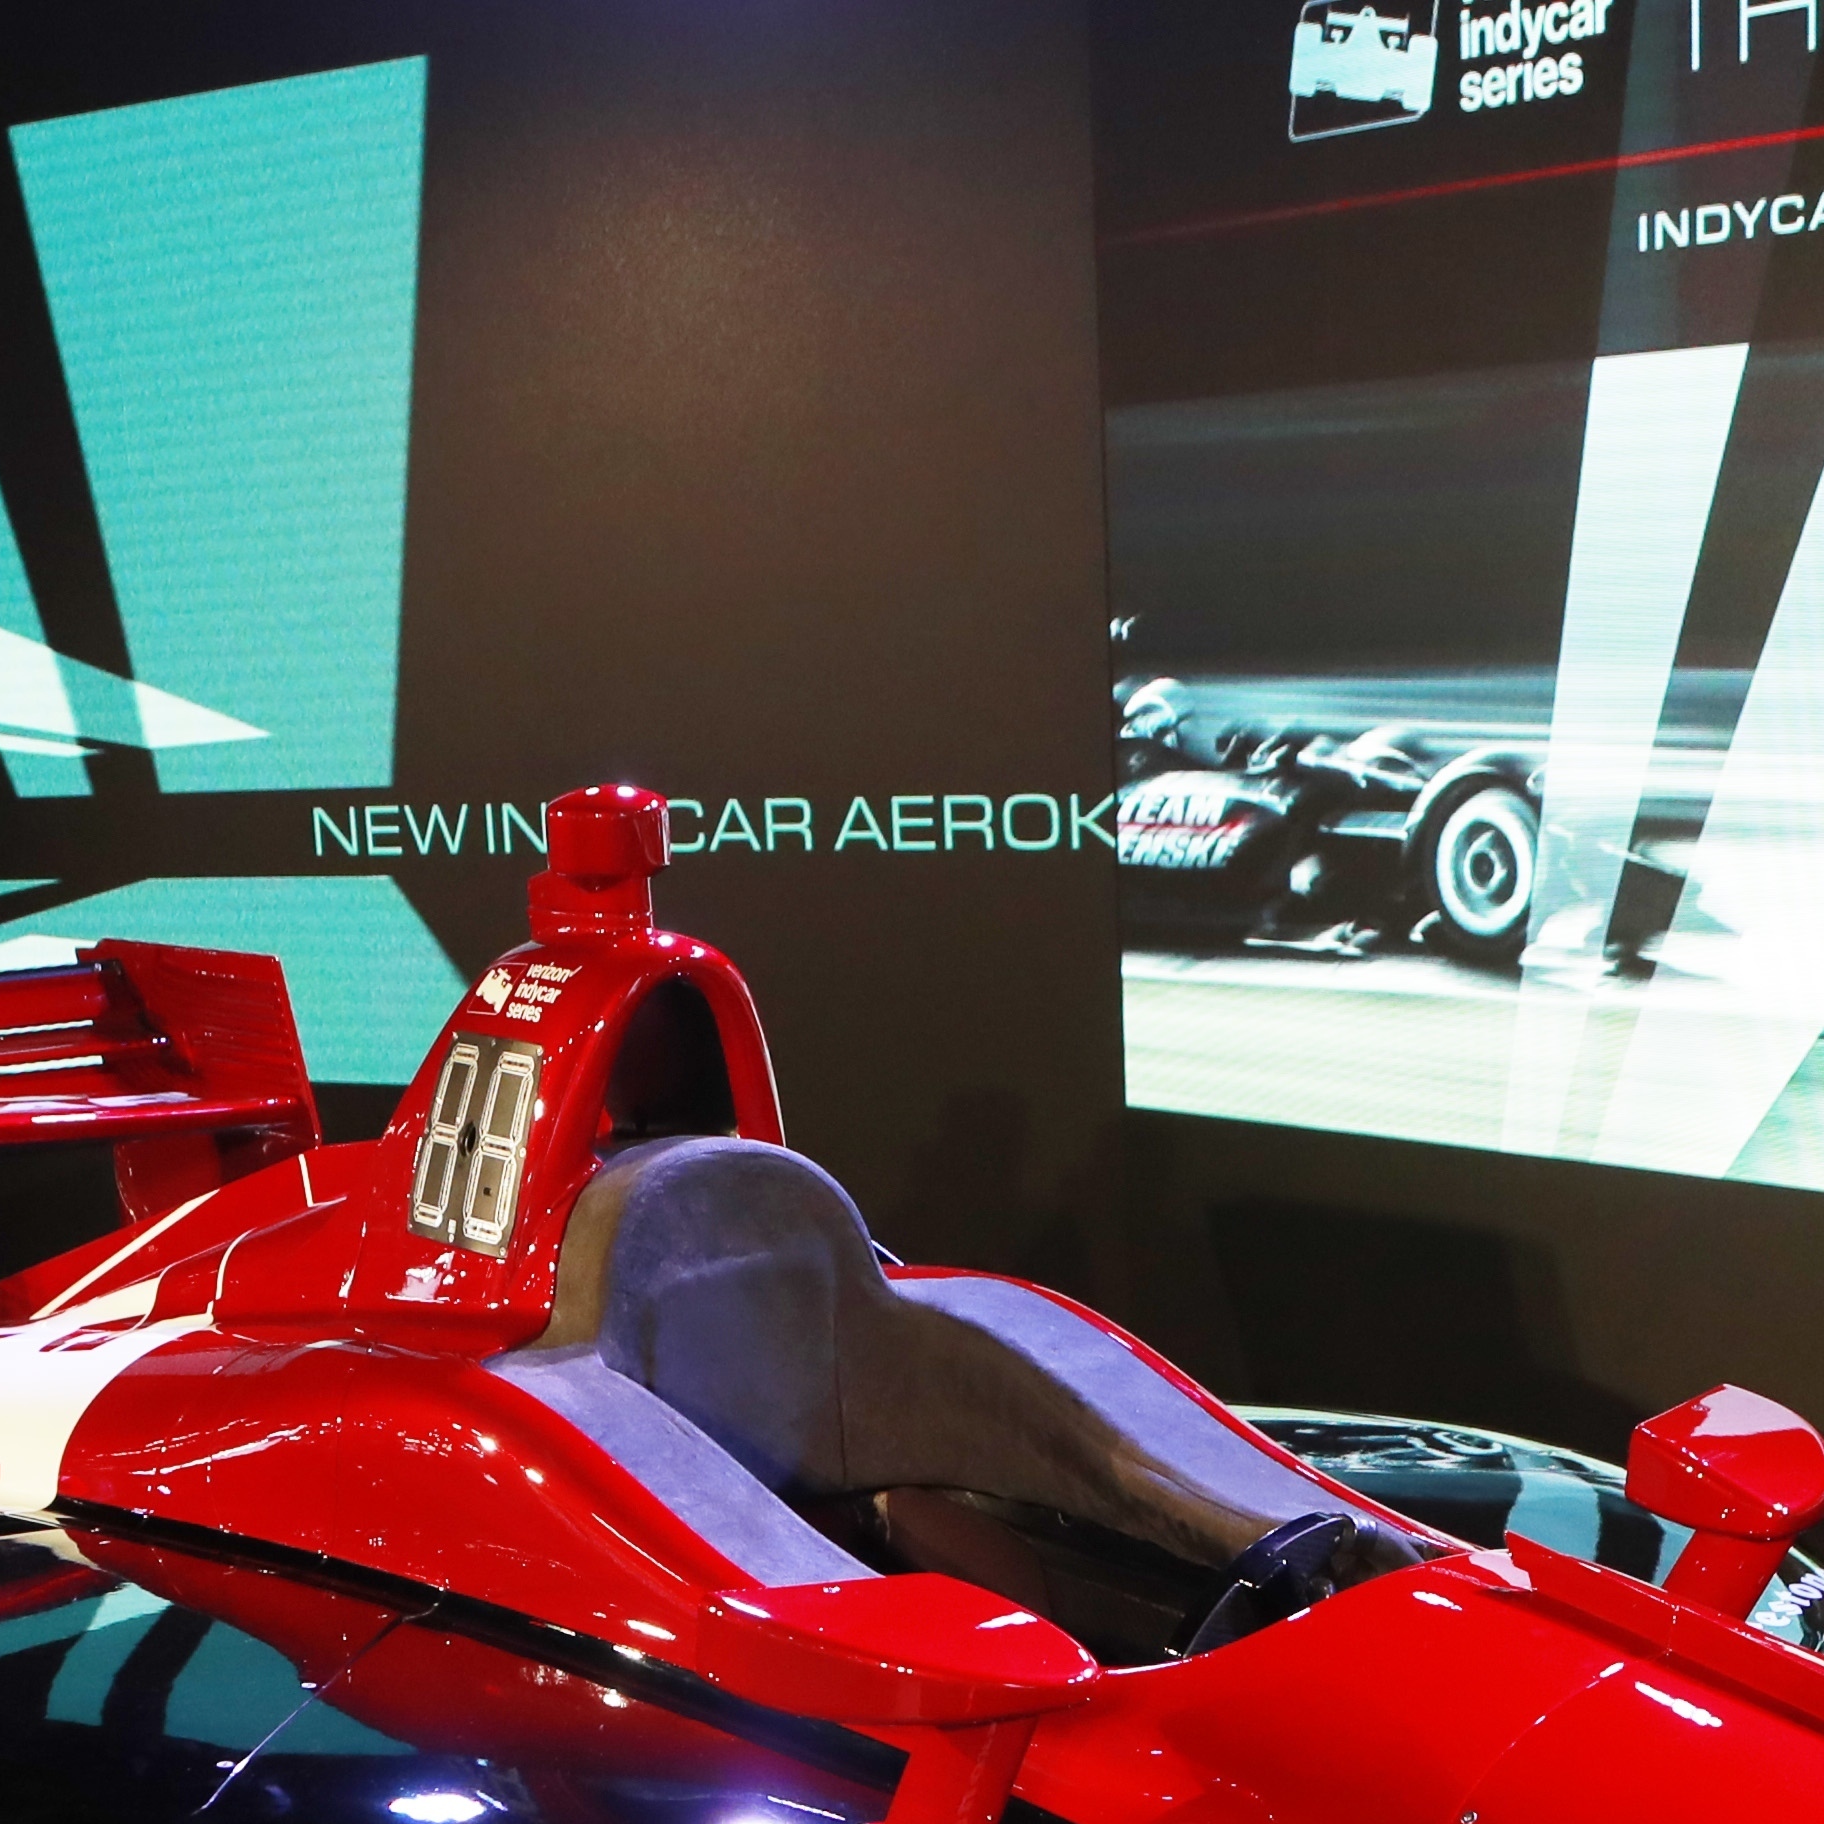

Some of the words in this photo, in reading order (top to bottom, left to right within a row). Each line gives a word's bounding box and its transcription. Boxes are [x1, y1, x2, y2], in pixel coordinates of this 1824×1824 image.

[1459, 0, 1614, 60] indycar
[1459, 52, 1585, 113] series
[312, 803, 468, 857] NEW
[486, 797, 814, 857] INCAR
[1117, 826, 1253, 868] ENSKE
[505, 1002, 543, 1023] series
[514, 979, 563, 1004] indycar
